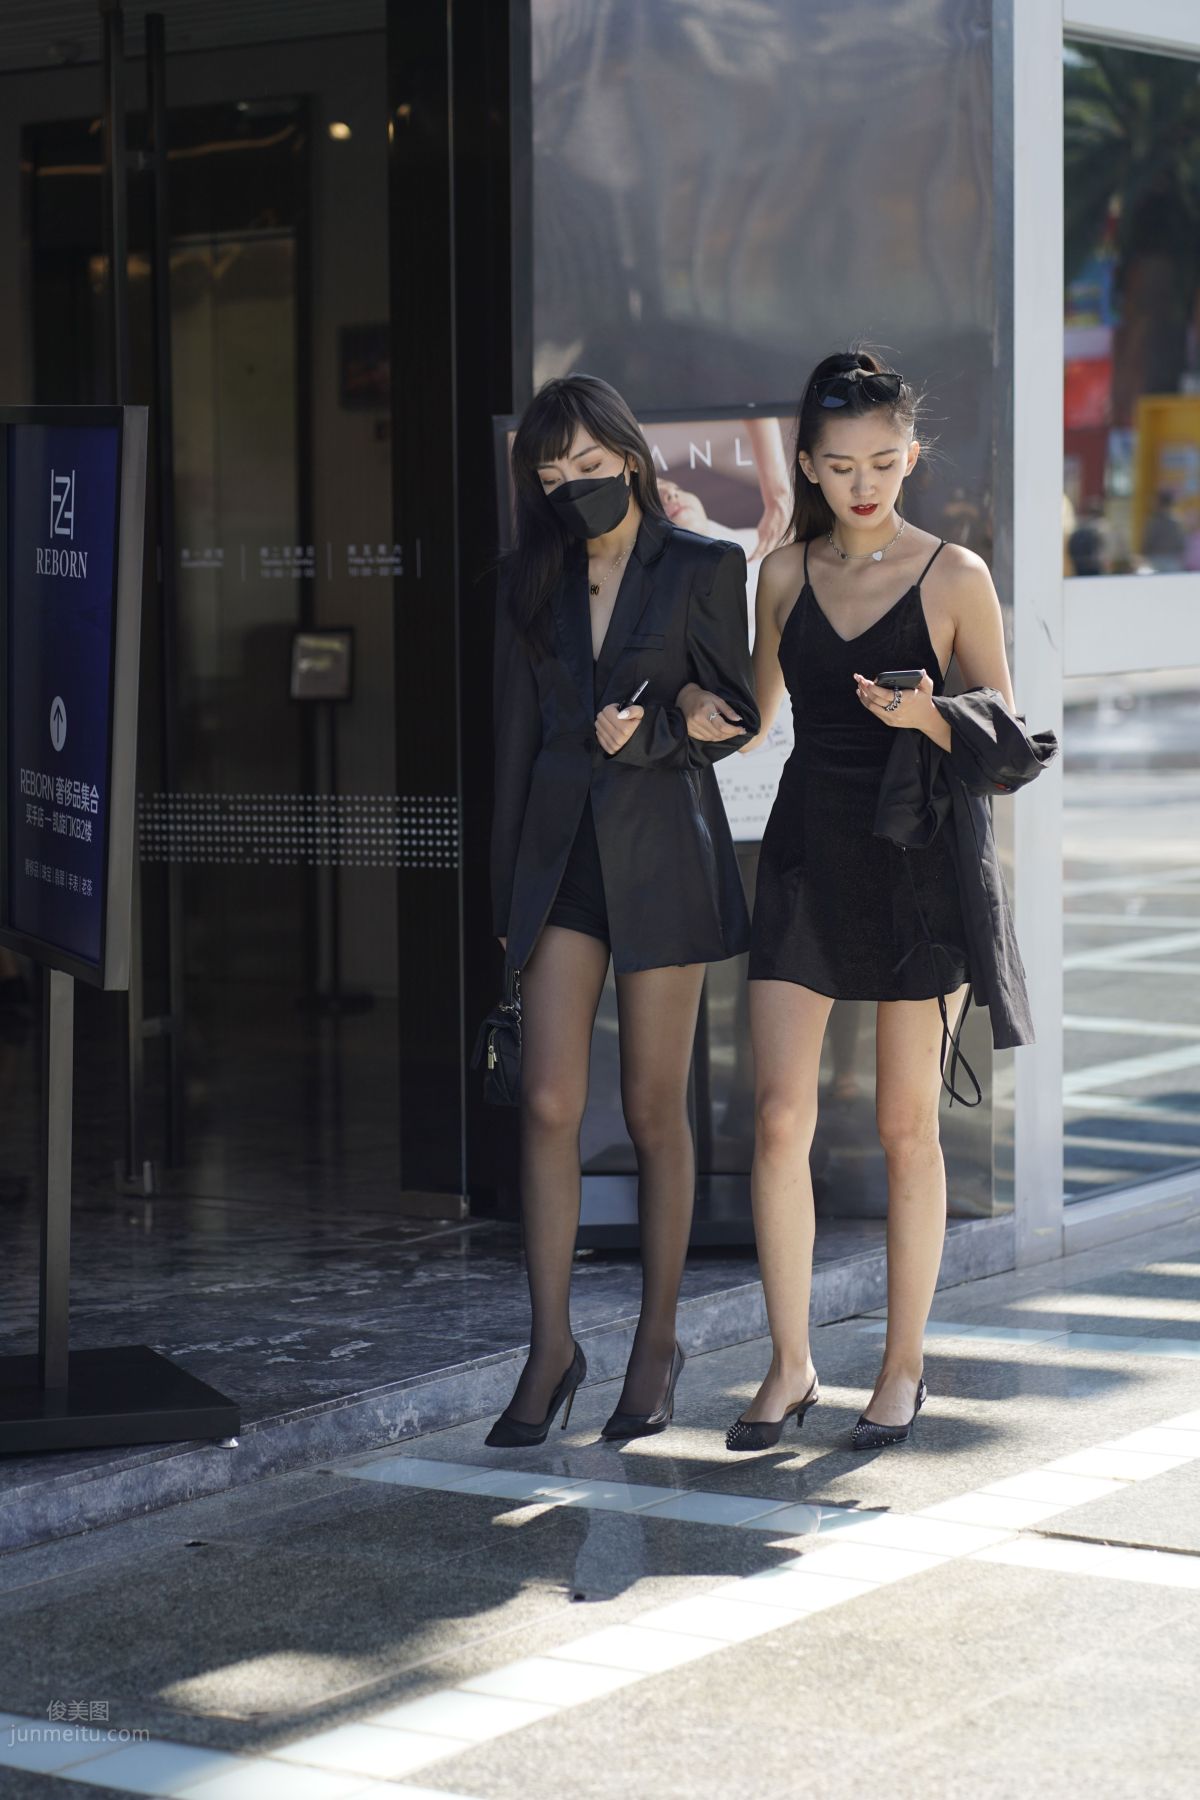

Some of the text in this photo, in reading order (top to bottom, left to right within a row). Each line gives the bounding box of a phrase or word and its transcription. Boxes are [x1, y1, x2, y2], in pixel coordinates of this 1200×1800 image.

[36, 547, 88, 579] REBORN
[20, 768, 99, 814] REBORN 奢侈品集合
